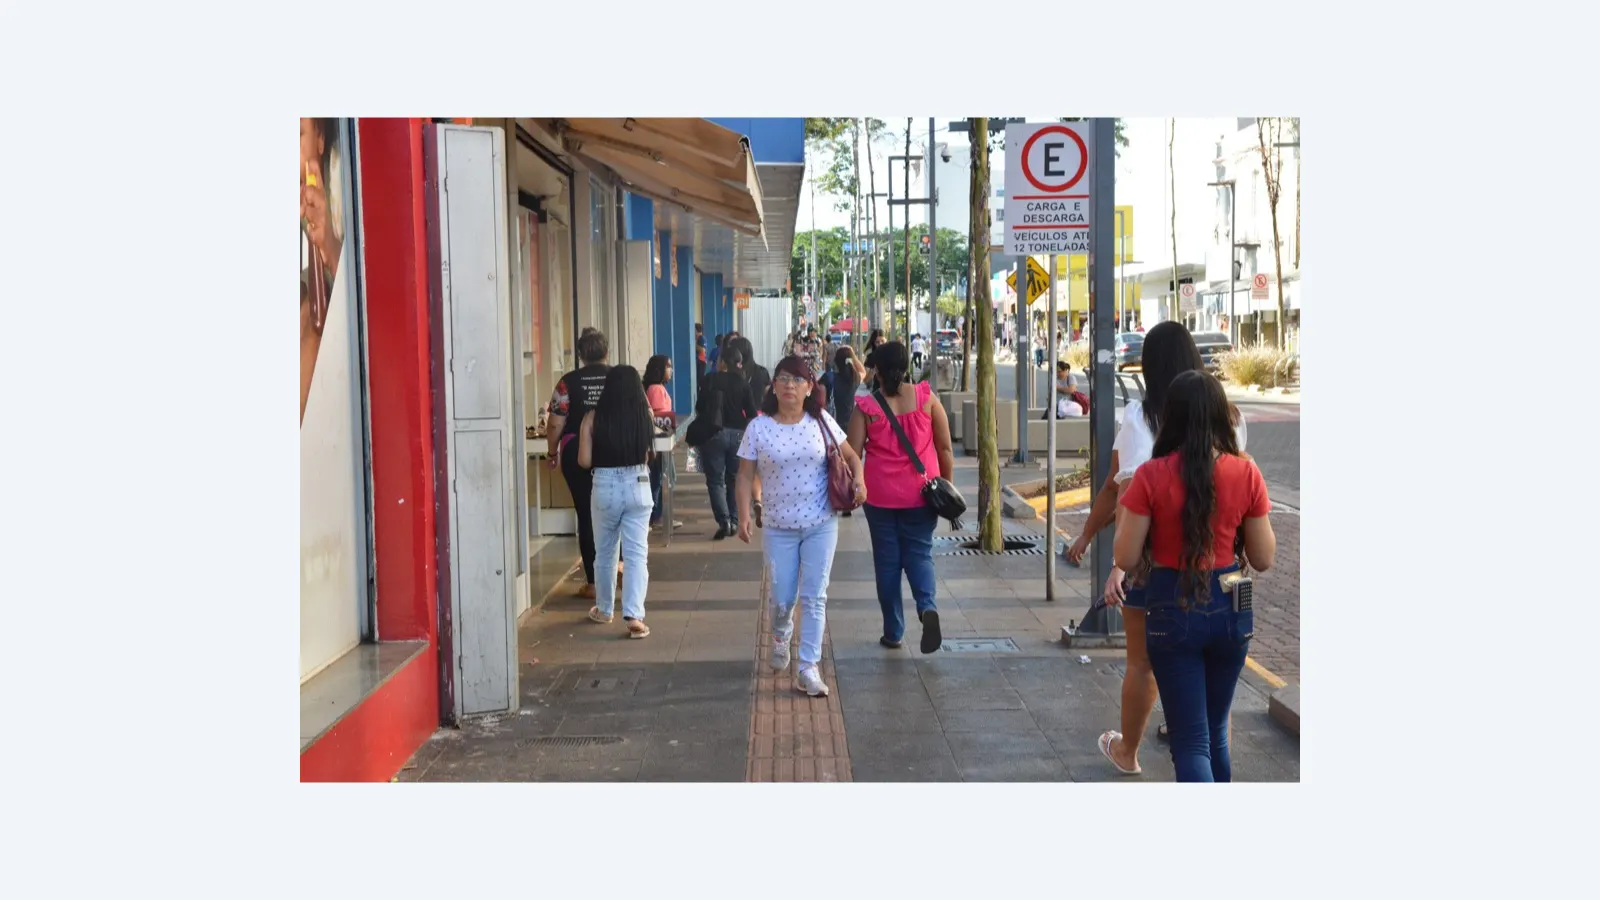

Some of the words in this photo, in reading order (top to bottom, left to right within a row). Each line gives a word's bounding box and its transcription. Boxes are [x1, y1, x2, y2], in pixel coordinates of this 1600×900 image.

[1044, 142, 1065, 176] E
[1026, 202, 1066, 211] CARGA
[1074, 202, 1081, 211] E
[1023, 213, 1085, 223] DESCARGA
[1014, 230, 1068, 241] VEÍCULOS
[1014, 244, 1025, 252] 12
